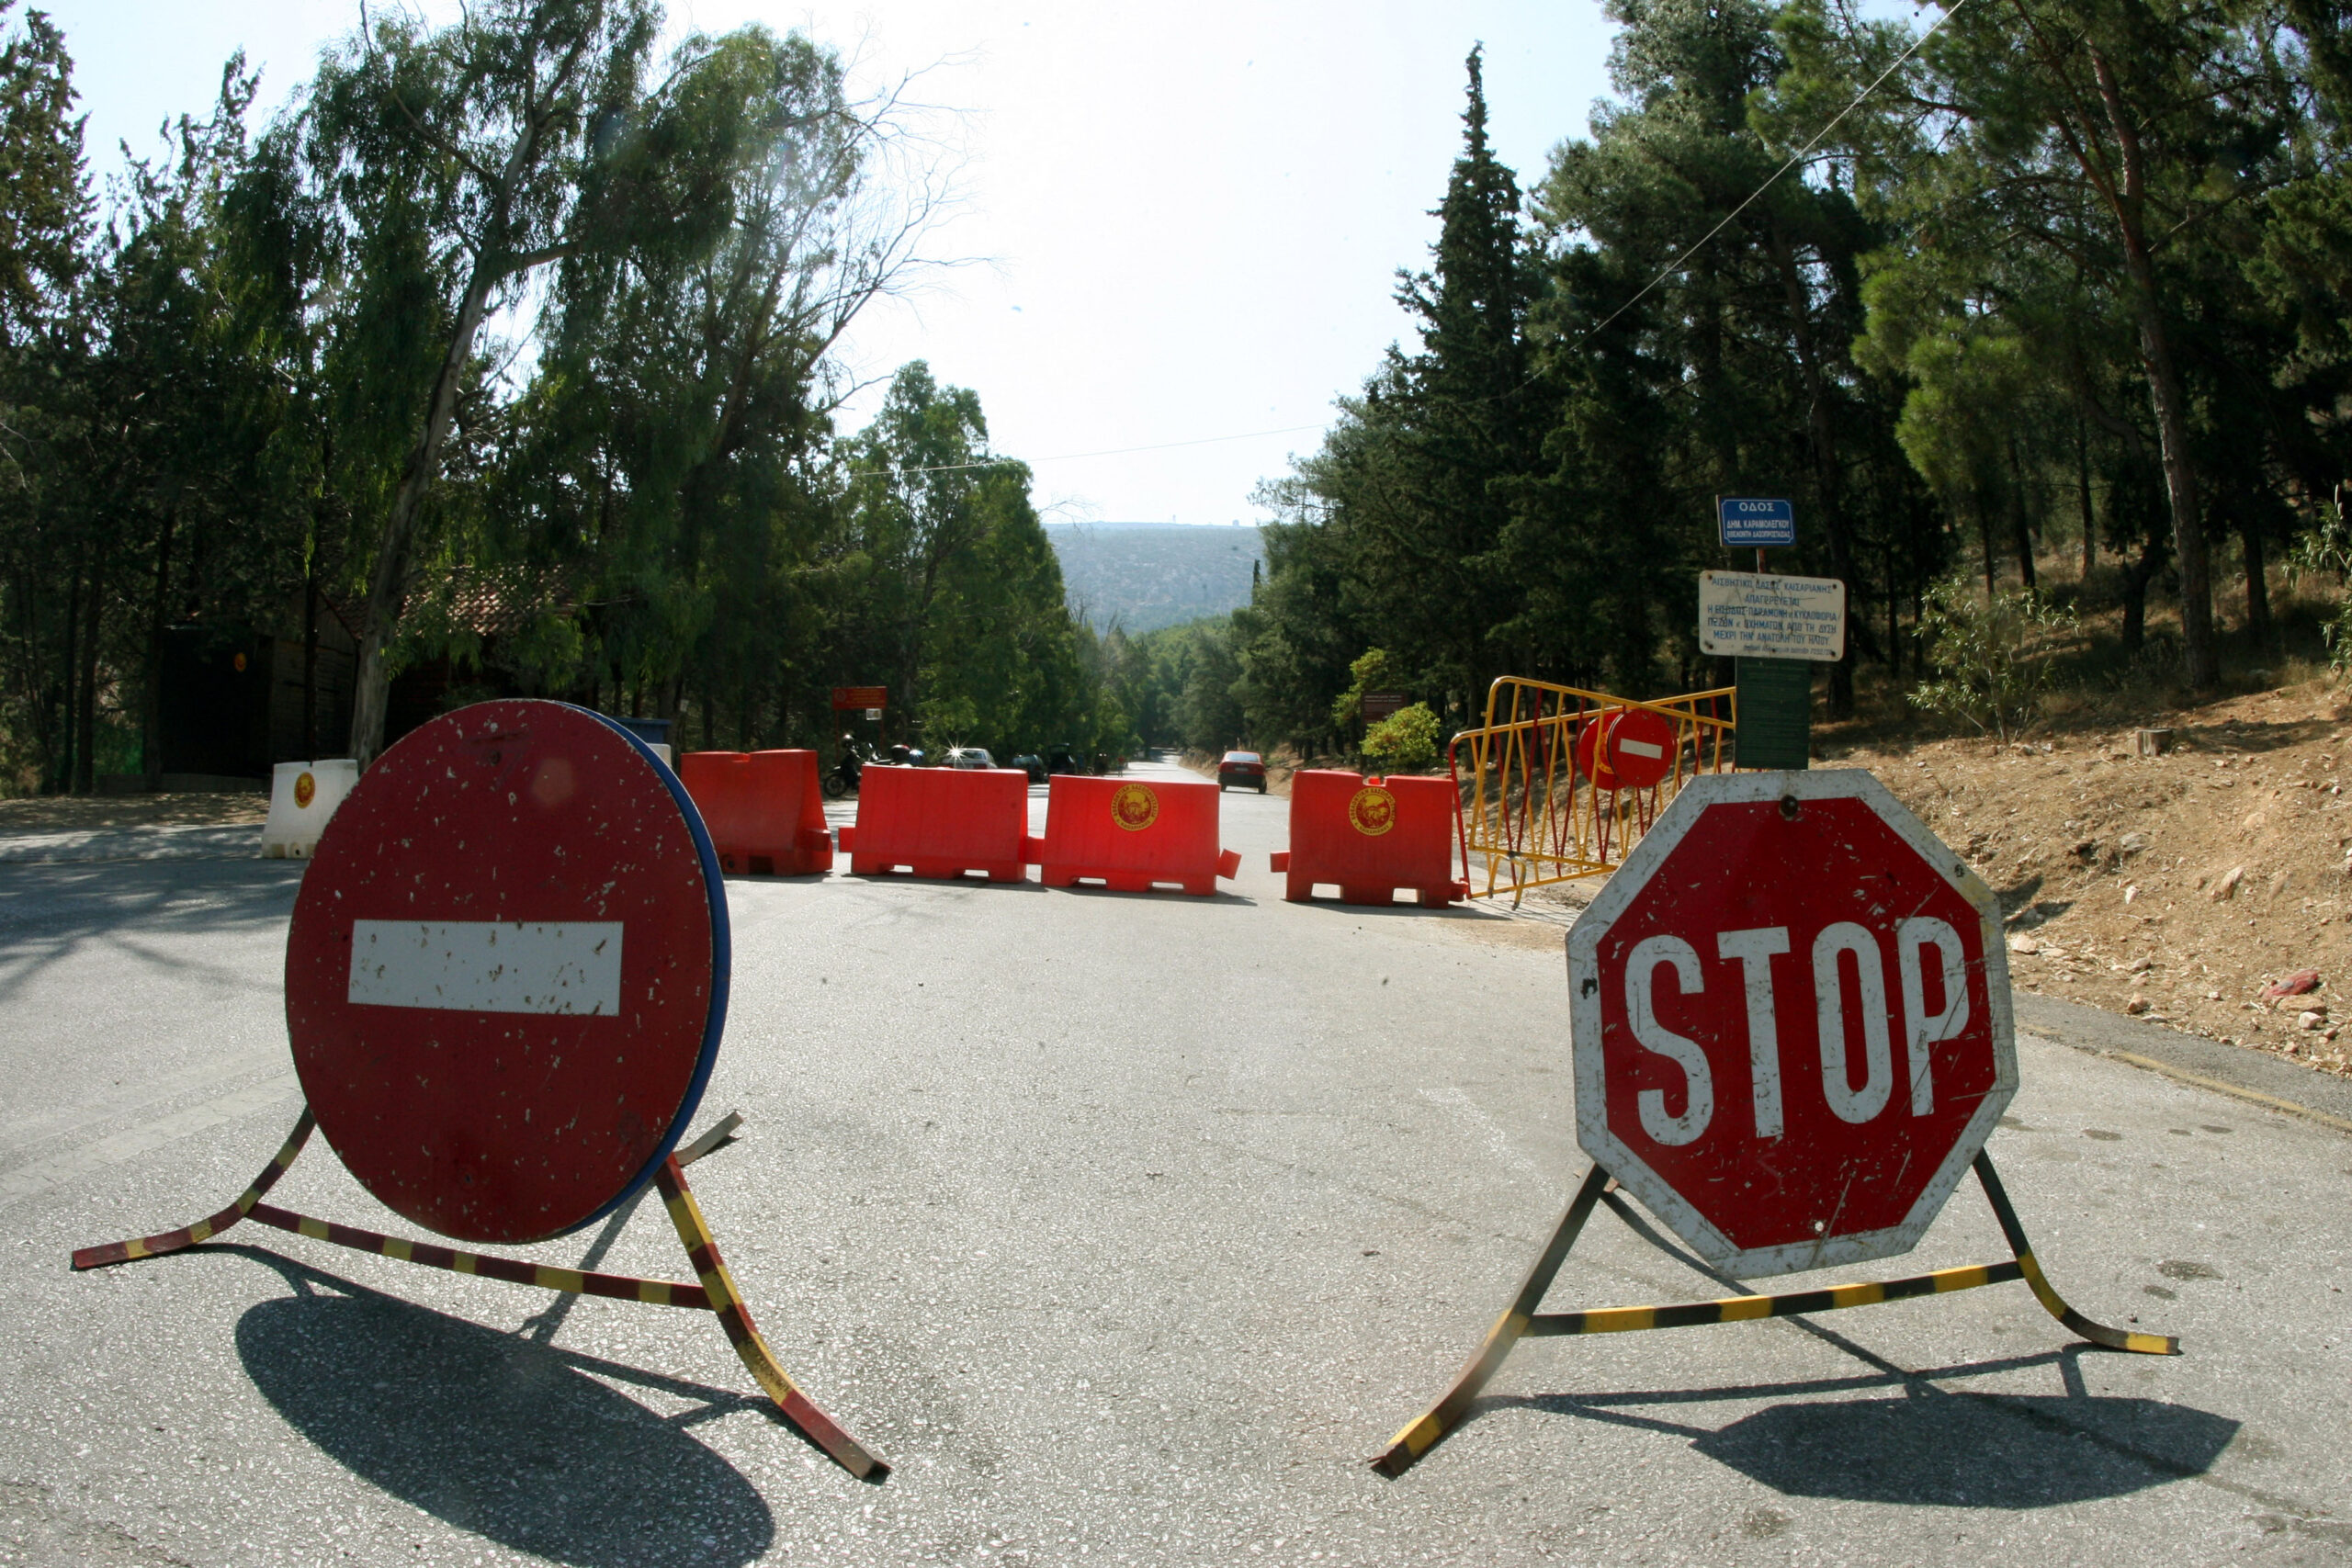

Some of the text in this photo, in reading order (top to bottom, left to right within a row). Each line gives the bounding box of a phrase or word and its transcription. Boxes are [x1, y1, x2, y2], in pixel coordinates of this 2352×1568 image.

[1738, 502, 1775, 512] ΟΔΟΣ
[1744, 519, 1790, 529] ΚΑΡΑΜΟΛΕΓΚΟΥ
[1784, 583, 1832, 594] ΚΑΙΣΑΡΙΑΝΗΣ
[1745, 593, 1800, 607] ΑΠΑΓΟΡΕΥΕΤΑΙ
[1707, 604, 1713, 614] Η
[1794, 608, 1838, 621] ΚΥΚΛΟΦΟΡΙΑ
[1744, 619, 1783, 630] ΟΧΗΜΑΤΩΝ
[1787, 621, 1803, 631] ΑΠΟ
[1805, 623, 1815, 633] ΤΗ
[1818, 624, 1837, 634] ΔΥΣΗ
[1713, 629, 1736, 640] ΜΕΧΡΙ
[1740, 631, 1754, 641] ΤΗΝ
[1757, 632, 1790, 643] ΑΝΑΤΟΛΗ
[1792, 635, 1804, 644] ΤΟΥ
[1623, 916, 1971, 1147] STOP
